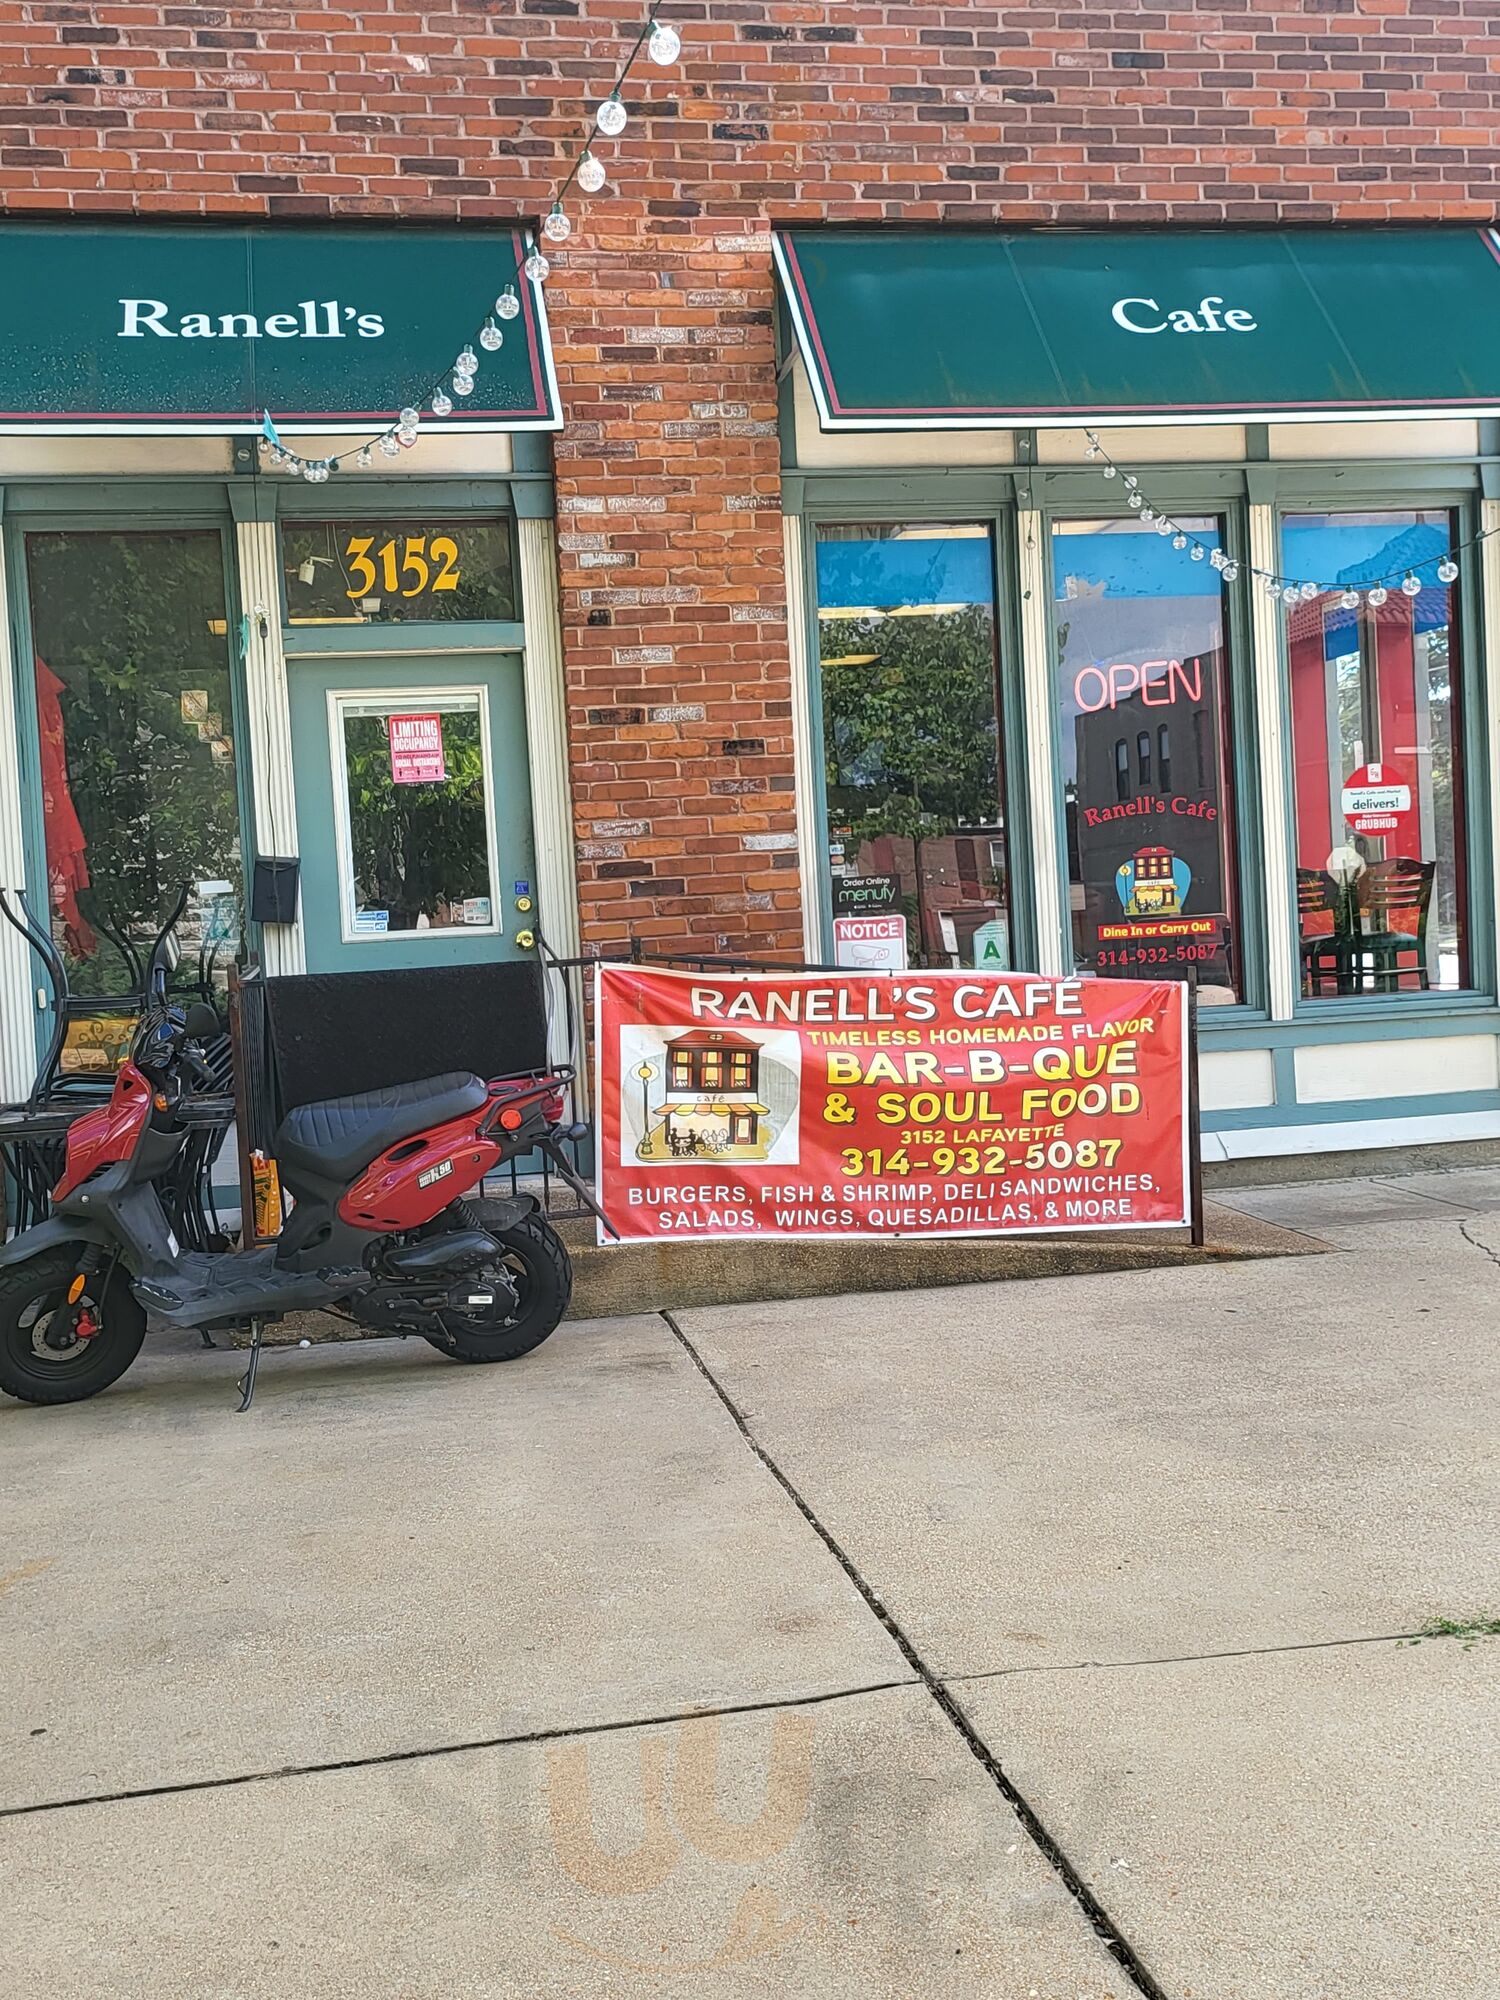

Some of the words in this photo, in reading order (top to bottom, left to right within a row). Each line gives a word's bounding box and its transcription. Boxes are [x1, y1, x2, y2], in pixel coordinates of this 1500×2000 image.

[117, 298, 385, 338] Ranell's
[1111, 297, 1258, 334] Cafe
[345, 536, 461, 599] 3152
[1074, 657, 1202, 712] OPEN
[392, 720, 438, 737] LIMITING
[394, 736, 438, 751] OCCUPANCY
[1084, 796, 1165, 827] Ranell's
[1171, 797, 1217, 821] Cafe
[1352, 797, 1399, 810] delivers!
[1355, 817, 1398, 830] GRUBHUB
[839, 885, 896, 903] menufy
[843, 879, 864, 887] Order
[866, 877, 890, 885] Online
[840, 922, 899, 939] NOTICE
[1103, 927, 1128, 938] Dine
[1131, 925, 1143, 936] In
[1146, 926, 1157, 935] or
[1159, 922, 1188, 935] Carry
[1190, 921, 1211, 932] Out
[983, 940, 1001, 959] A
[1097, 943, 1217, 966] 314-932-5087
[690, 985, 938, 1023] RANELL'S
[953, 976, 1084, 1018] CAFÉ
[807, 1029, 921, 1046] TIMELESS
[930, 1025, 1063, 1044] HOMEMADE
[1072, 1018, 1154, 1039] FLAVOR
[826, 1040, 1137, 1085] BAR-B-QUE
[822, 1093, 857, 1124] &
[876, 1091, 1004, 1124] SOUL
[1021, 1082, 1141, 1120] FOOD
[901, 1131, 945, 1144] 3152
[953, 1124, 1065, 1143] LAFAYETTE
[841, 1139, 1122, 1176] 314-932-5087
[628, 1186, 753, 1205] BURGERS,
[761, 1186, 813, 1203] FISH
[821, 1186, 836, 1202] &
[843, 1184, 937, 1204] SHRIMP,
[944, 1183, 995, 1201] DELI
[1001, 1174, 1160, 1198] SANDWICHES,
[658, 1210, 763, 1230] SALADS,
[775, 1209, 860, 1227] WINGS,
[868, 1203, 1038, 1226] QUESADILLAS,
[1046, 1203, 1059, 1218] &
[1066, 1199, 1132, 1217] MORE
